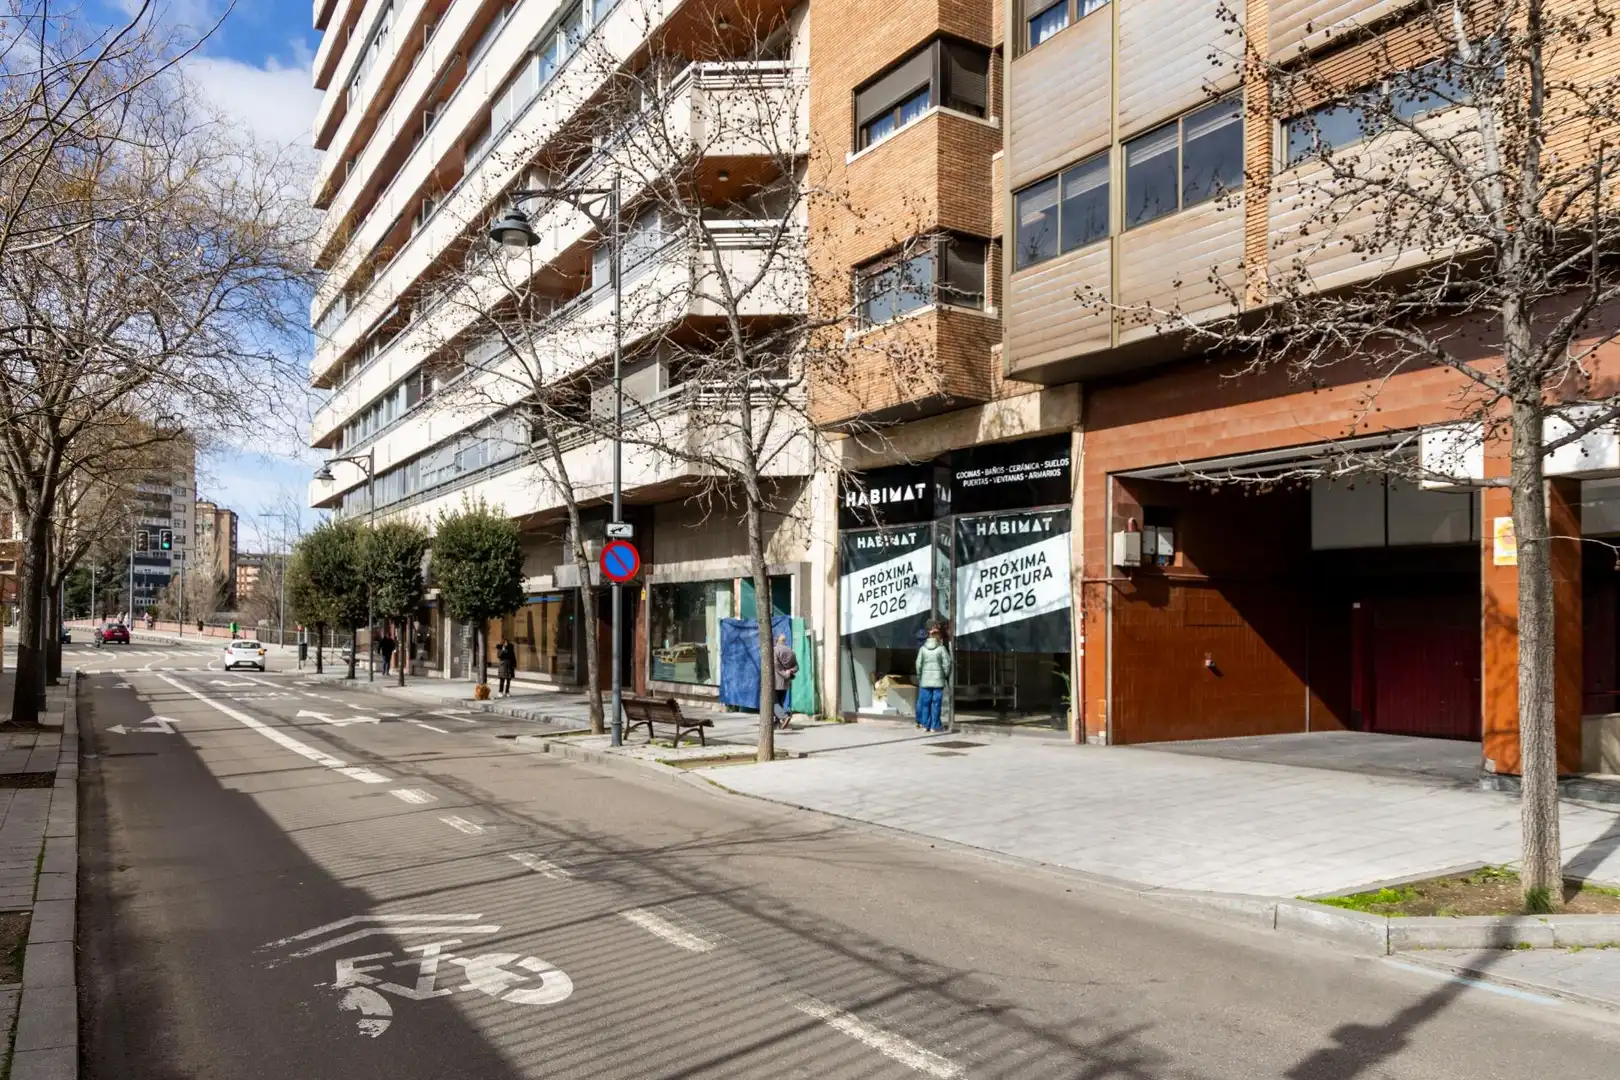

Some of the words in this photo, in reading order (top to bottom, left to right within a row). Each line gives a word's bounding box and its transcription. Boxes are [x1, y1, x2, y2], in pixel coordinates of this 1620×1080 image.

[956, 469, 981, 480] COCINAS
[984, 466, 1005, 476] BAÑOS
[1008, 462, 1040, 473] CERÁMICA
[1044, 457, 1070, 469] SUELOS
[963, 477, 989, 488] PUERTAS
[992, 473, 1024, 484] VENTANAS
[1028, 468, 1062, 480] ARMARIOS
[846, 482, 926, 508] HABIMAT
[976, 516, 1053, 537] HABIMAT
[862, 561, 914, 589] PRÓXIMA
[980, 550, 1047, 583] PRÓXIMA
[857, 574, 919, 605] APERTURA
[974, 565, 1053, 601] APERTURA
[869, 593, 908, 619] 2026
[988, 588, 1037, 618] 2026
